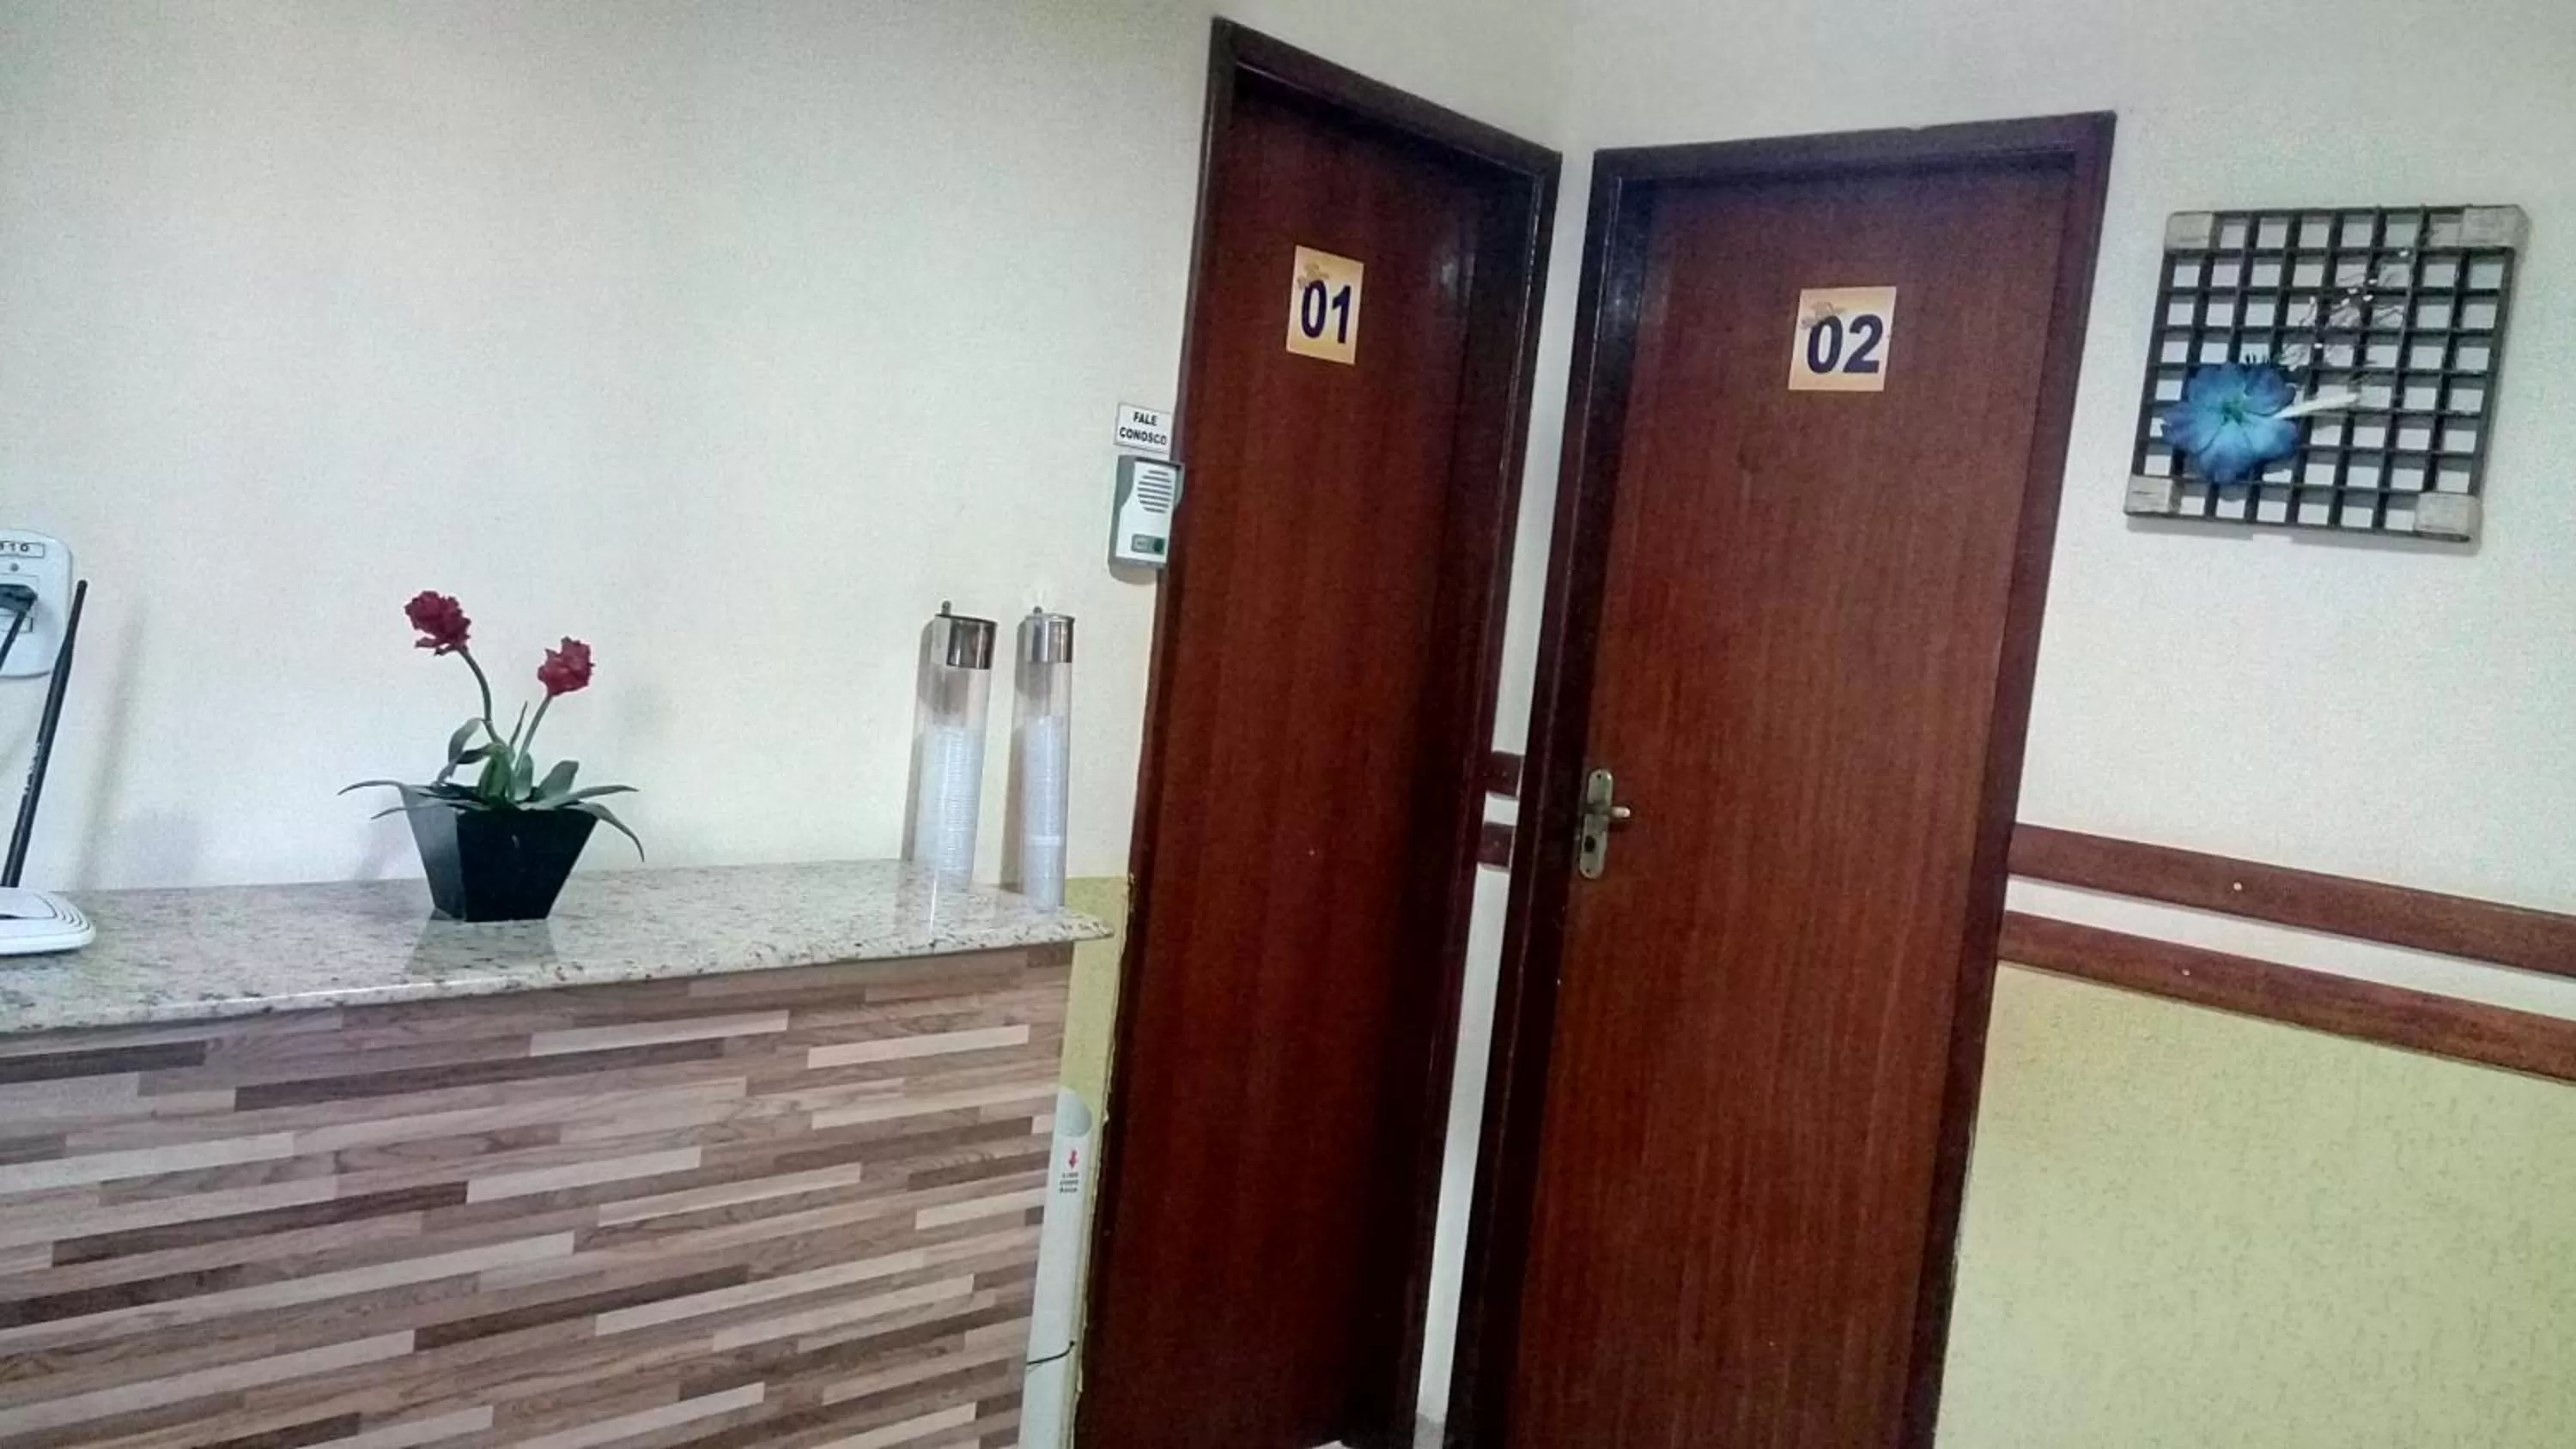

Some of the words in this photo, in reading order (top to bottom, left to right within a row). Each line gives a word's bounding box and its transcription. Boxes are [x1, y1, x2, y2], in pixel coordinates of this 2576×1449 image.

[1301, 280, 1351, 344] 01
[1807, 314, 1883, 374] 02
[1119, 427, 1168, 446] CONOSCO
[1133, 411, 1157, 427] FALE
